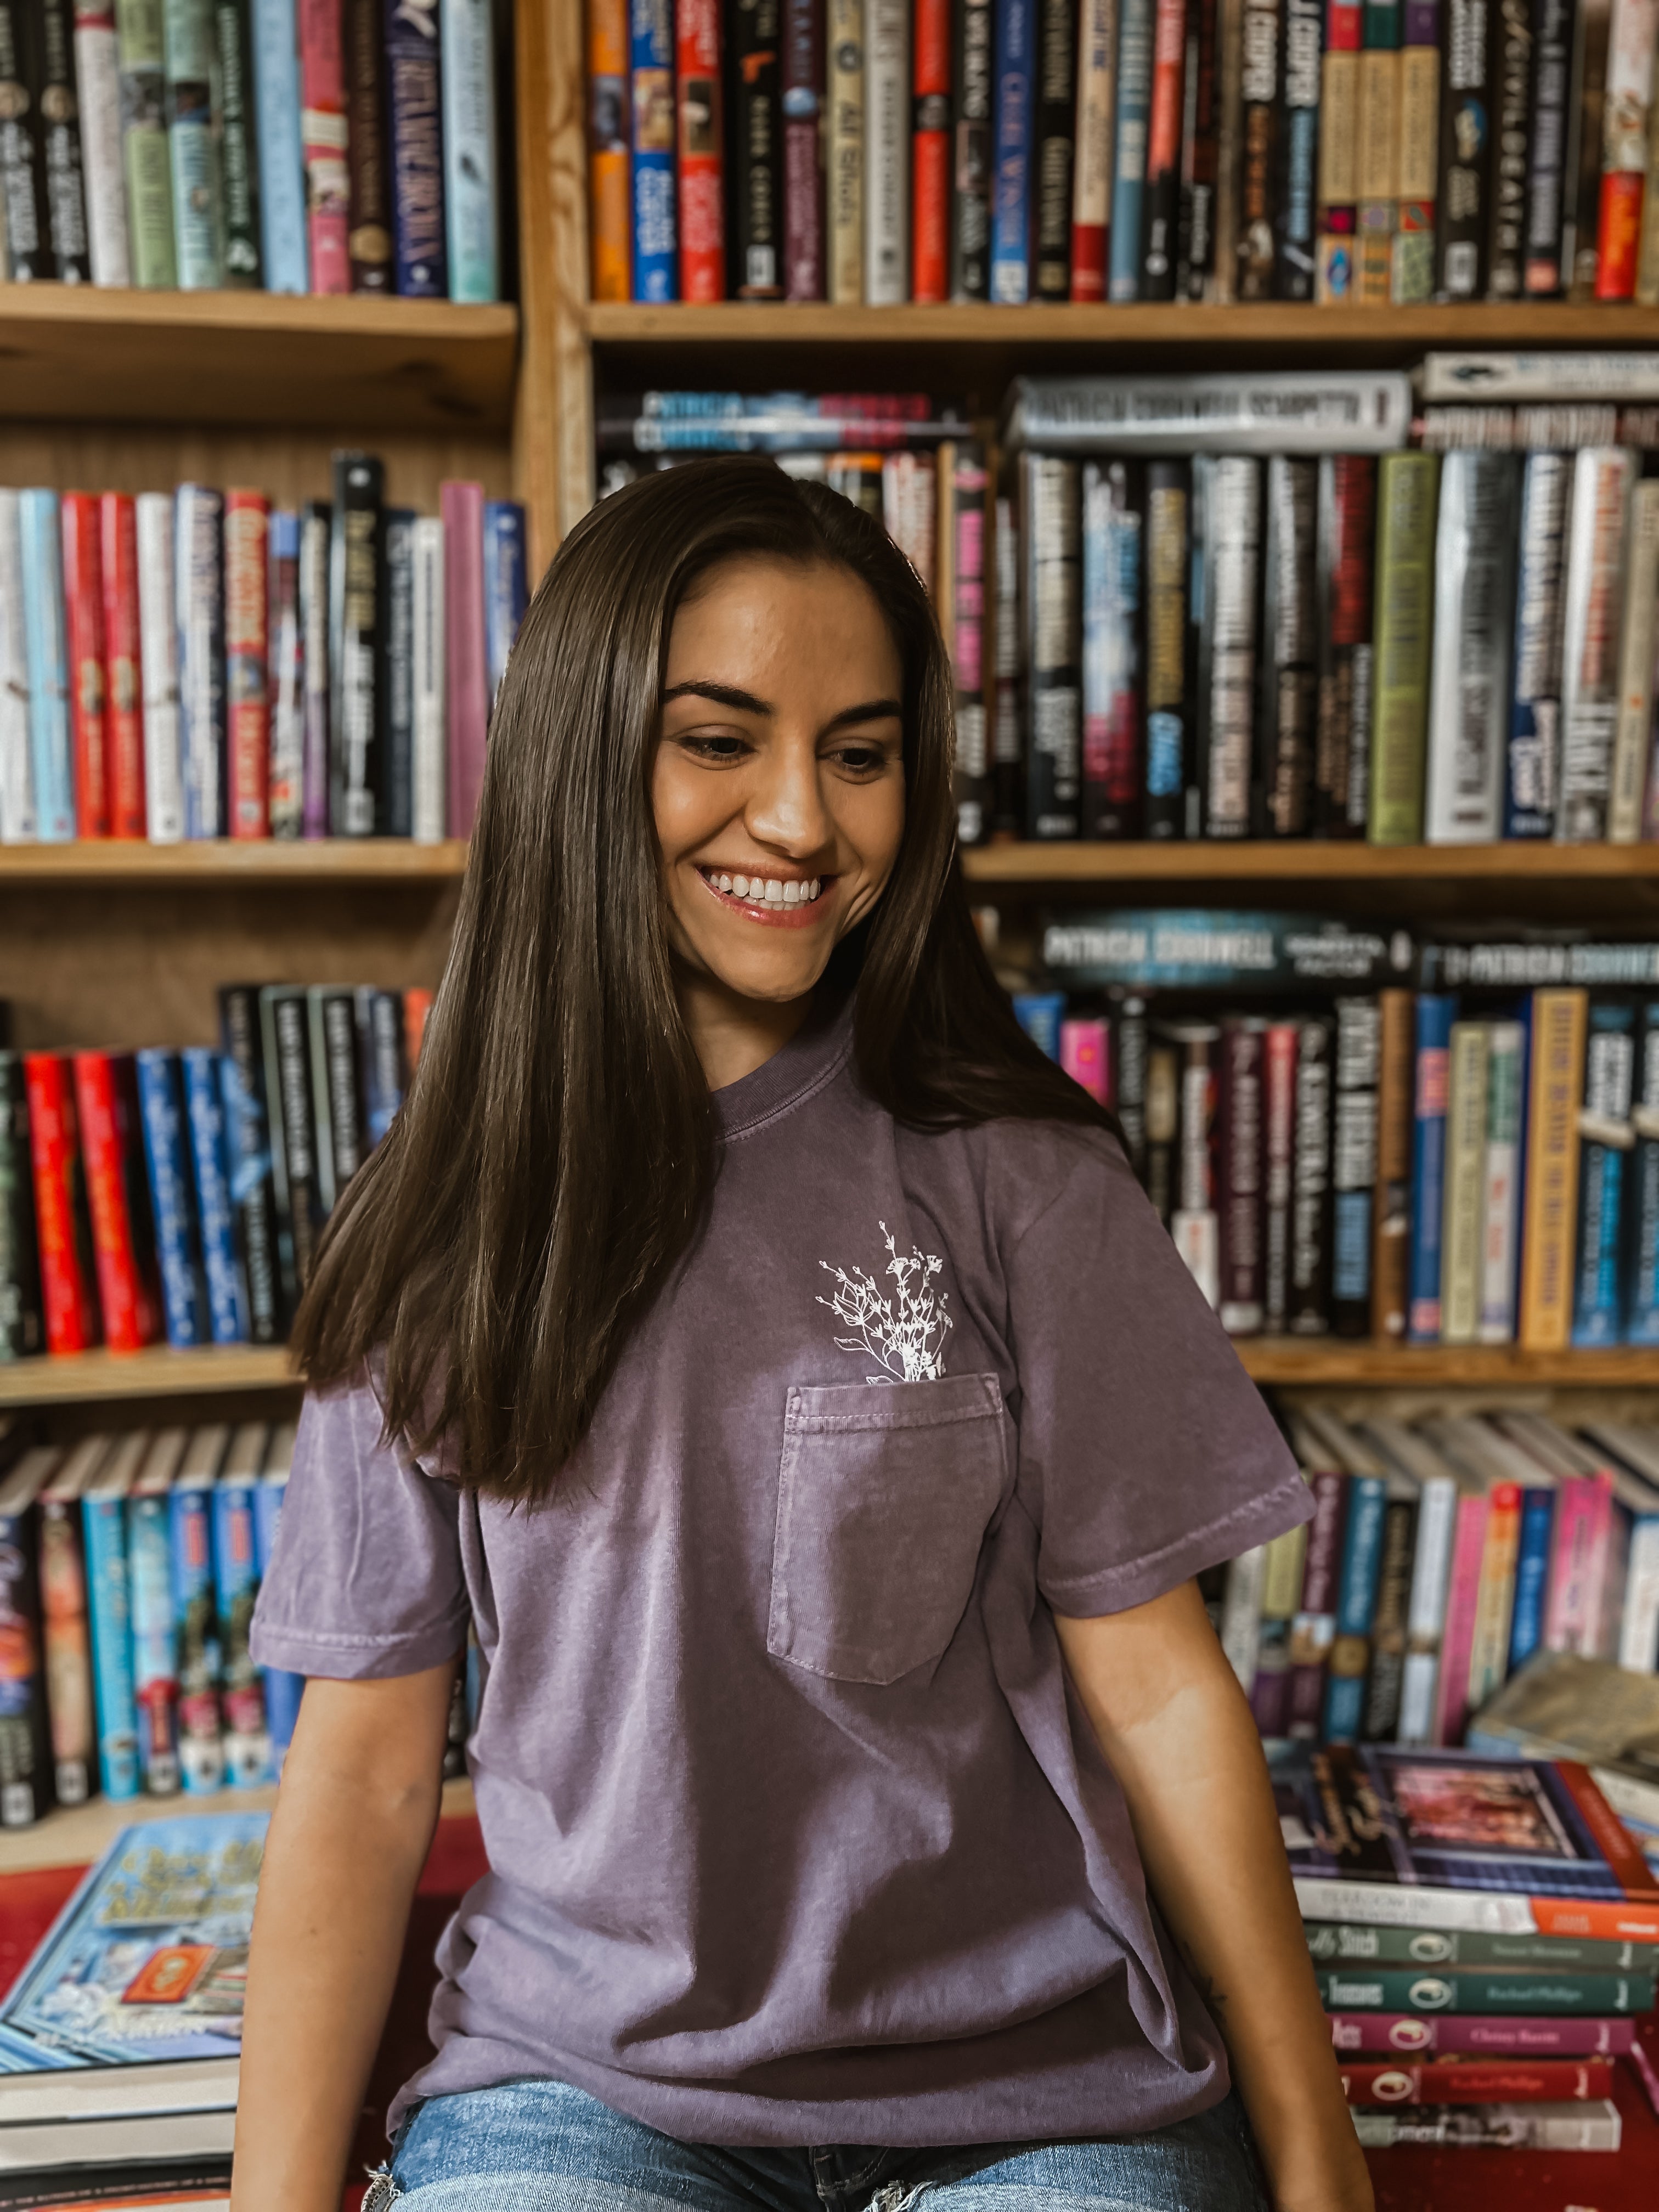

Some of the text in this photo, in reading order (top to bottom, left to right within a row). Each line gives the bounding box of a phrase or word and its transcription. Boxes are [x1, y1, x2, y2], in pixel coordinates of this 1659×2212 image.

[1242, 12, 1277, 100] COOPER
[1285, 18, 1321, 106] COOPER
[227, 124, 248, 225] DETECTIVE
[1496, 131, 1527, 249] DEATH
[1044, 927, 1276, 970] PATRICIA CORNWELL
[1294, 957, 1372, 977] FACTOR
[1534, 1986, 1582, 2004] Phillips
